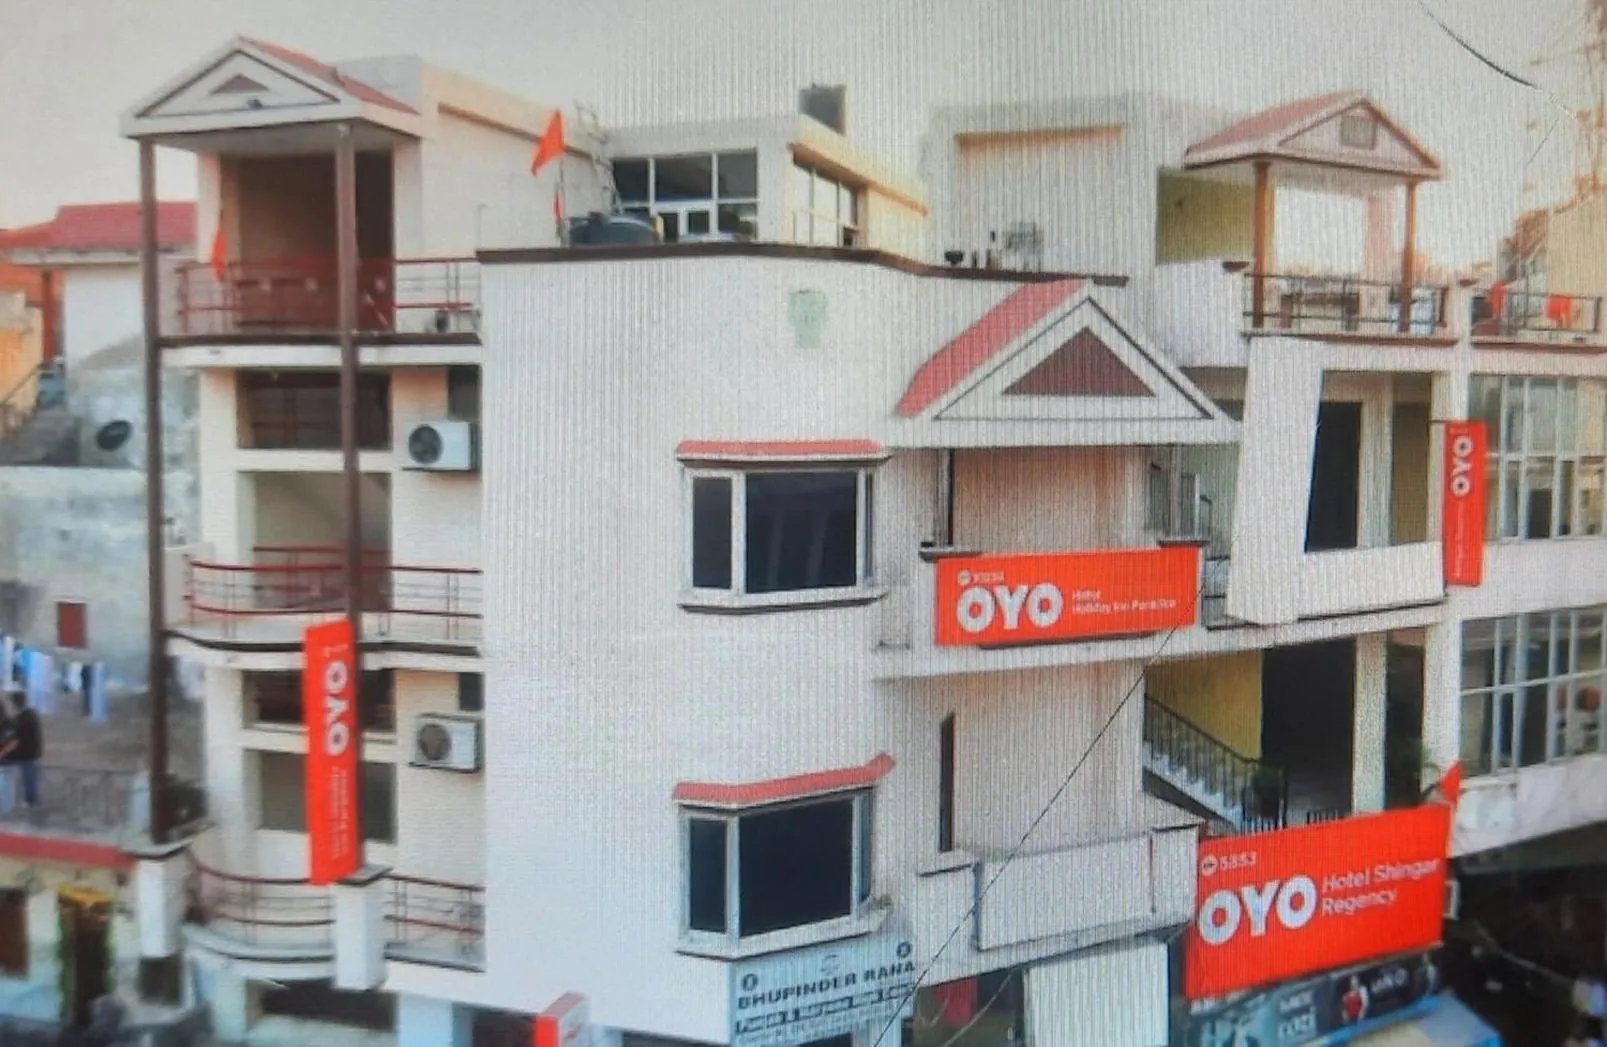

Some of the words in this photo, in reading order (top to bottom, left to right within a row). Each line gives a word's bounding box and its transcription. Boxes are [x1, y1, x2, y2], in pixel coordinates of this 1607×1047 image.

[1452, 436, 1473, 496] OYO
[957, 583, 1063, 633] OYO
[325, 660, 349, 755] OYO
[1322, 868, 1370, 892] Hotel
[1322, 888, 1397, 916] Regency
[1198, 874, 1317, 946] OYO
[738, 973, 857, 1010] BHUPINDER
[863, 961, 915, 981] RANA
